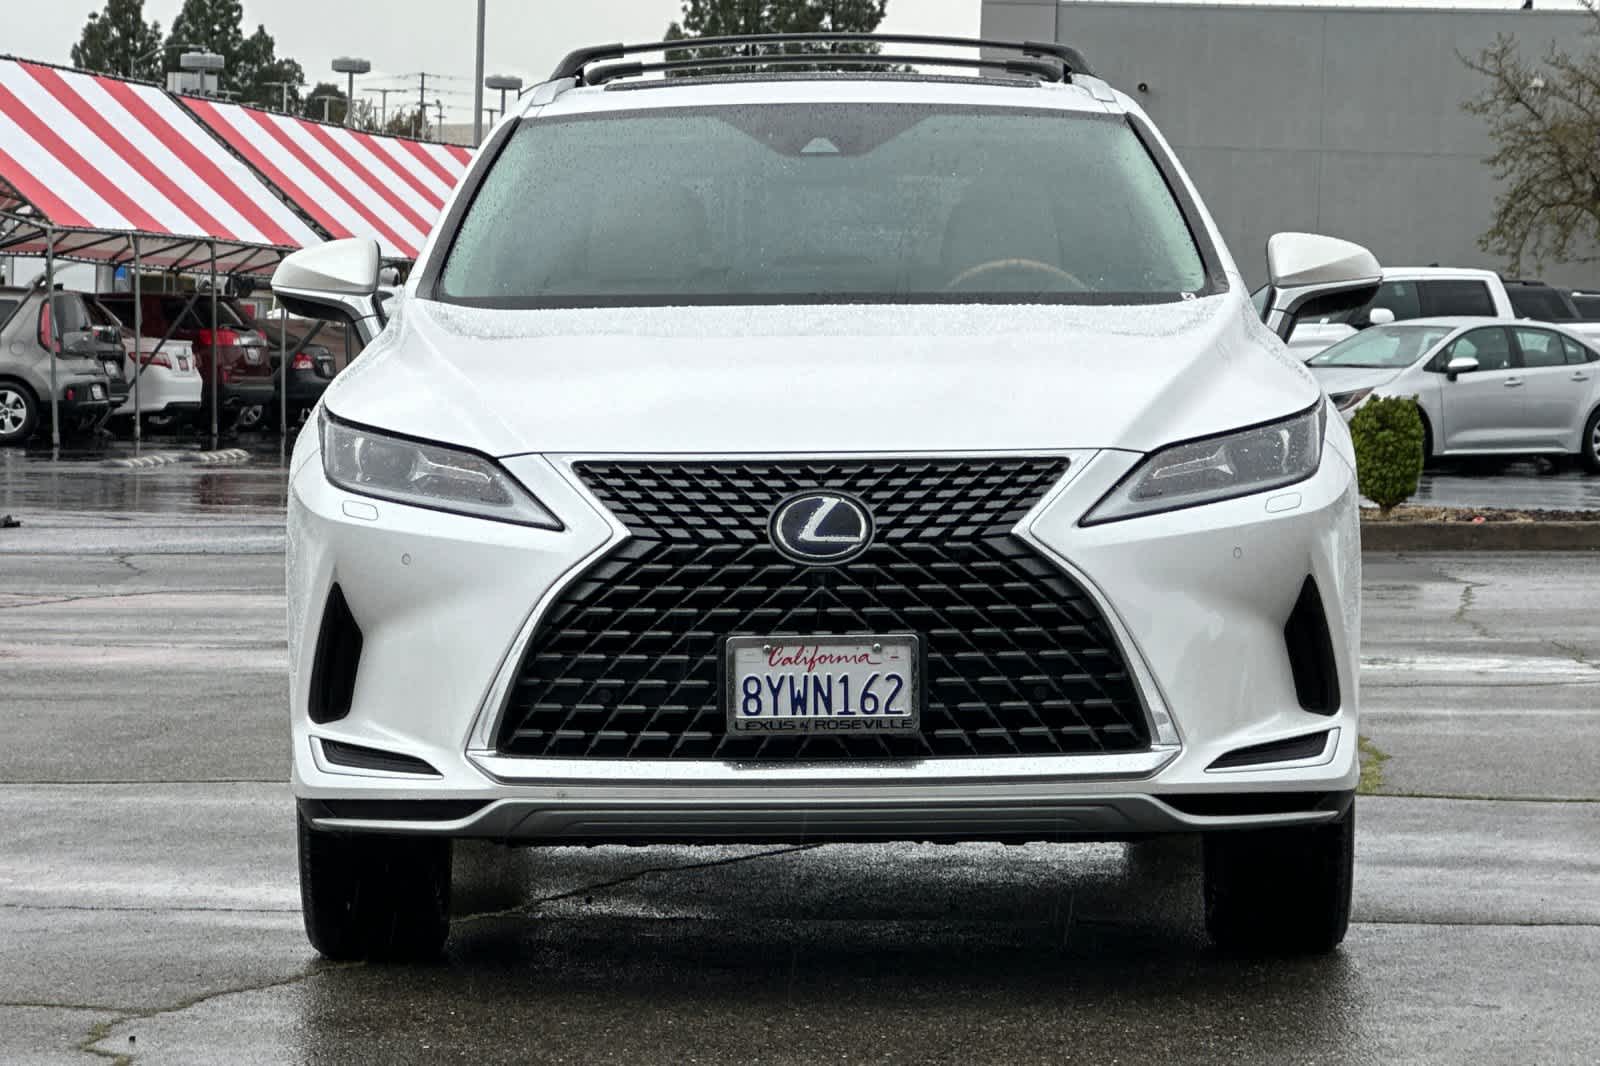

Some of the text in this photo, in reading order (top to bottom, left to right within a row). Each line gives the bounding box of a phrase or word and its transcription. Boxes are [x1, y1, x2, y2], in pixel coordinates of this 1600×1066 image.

[768, 645, 881, 672] California
[742, 673, 904, 716] 8YWN162
[735, 719, 796, 731] LEXUS
[815, 718, 913, 730] ROSEVILLE
